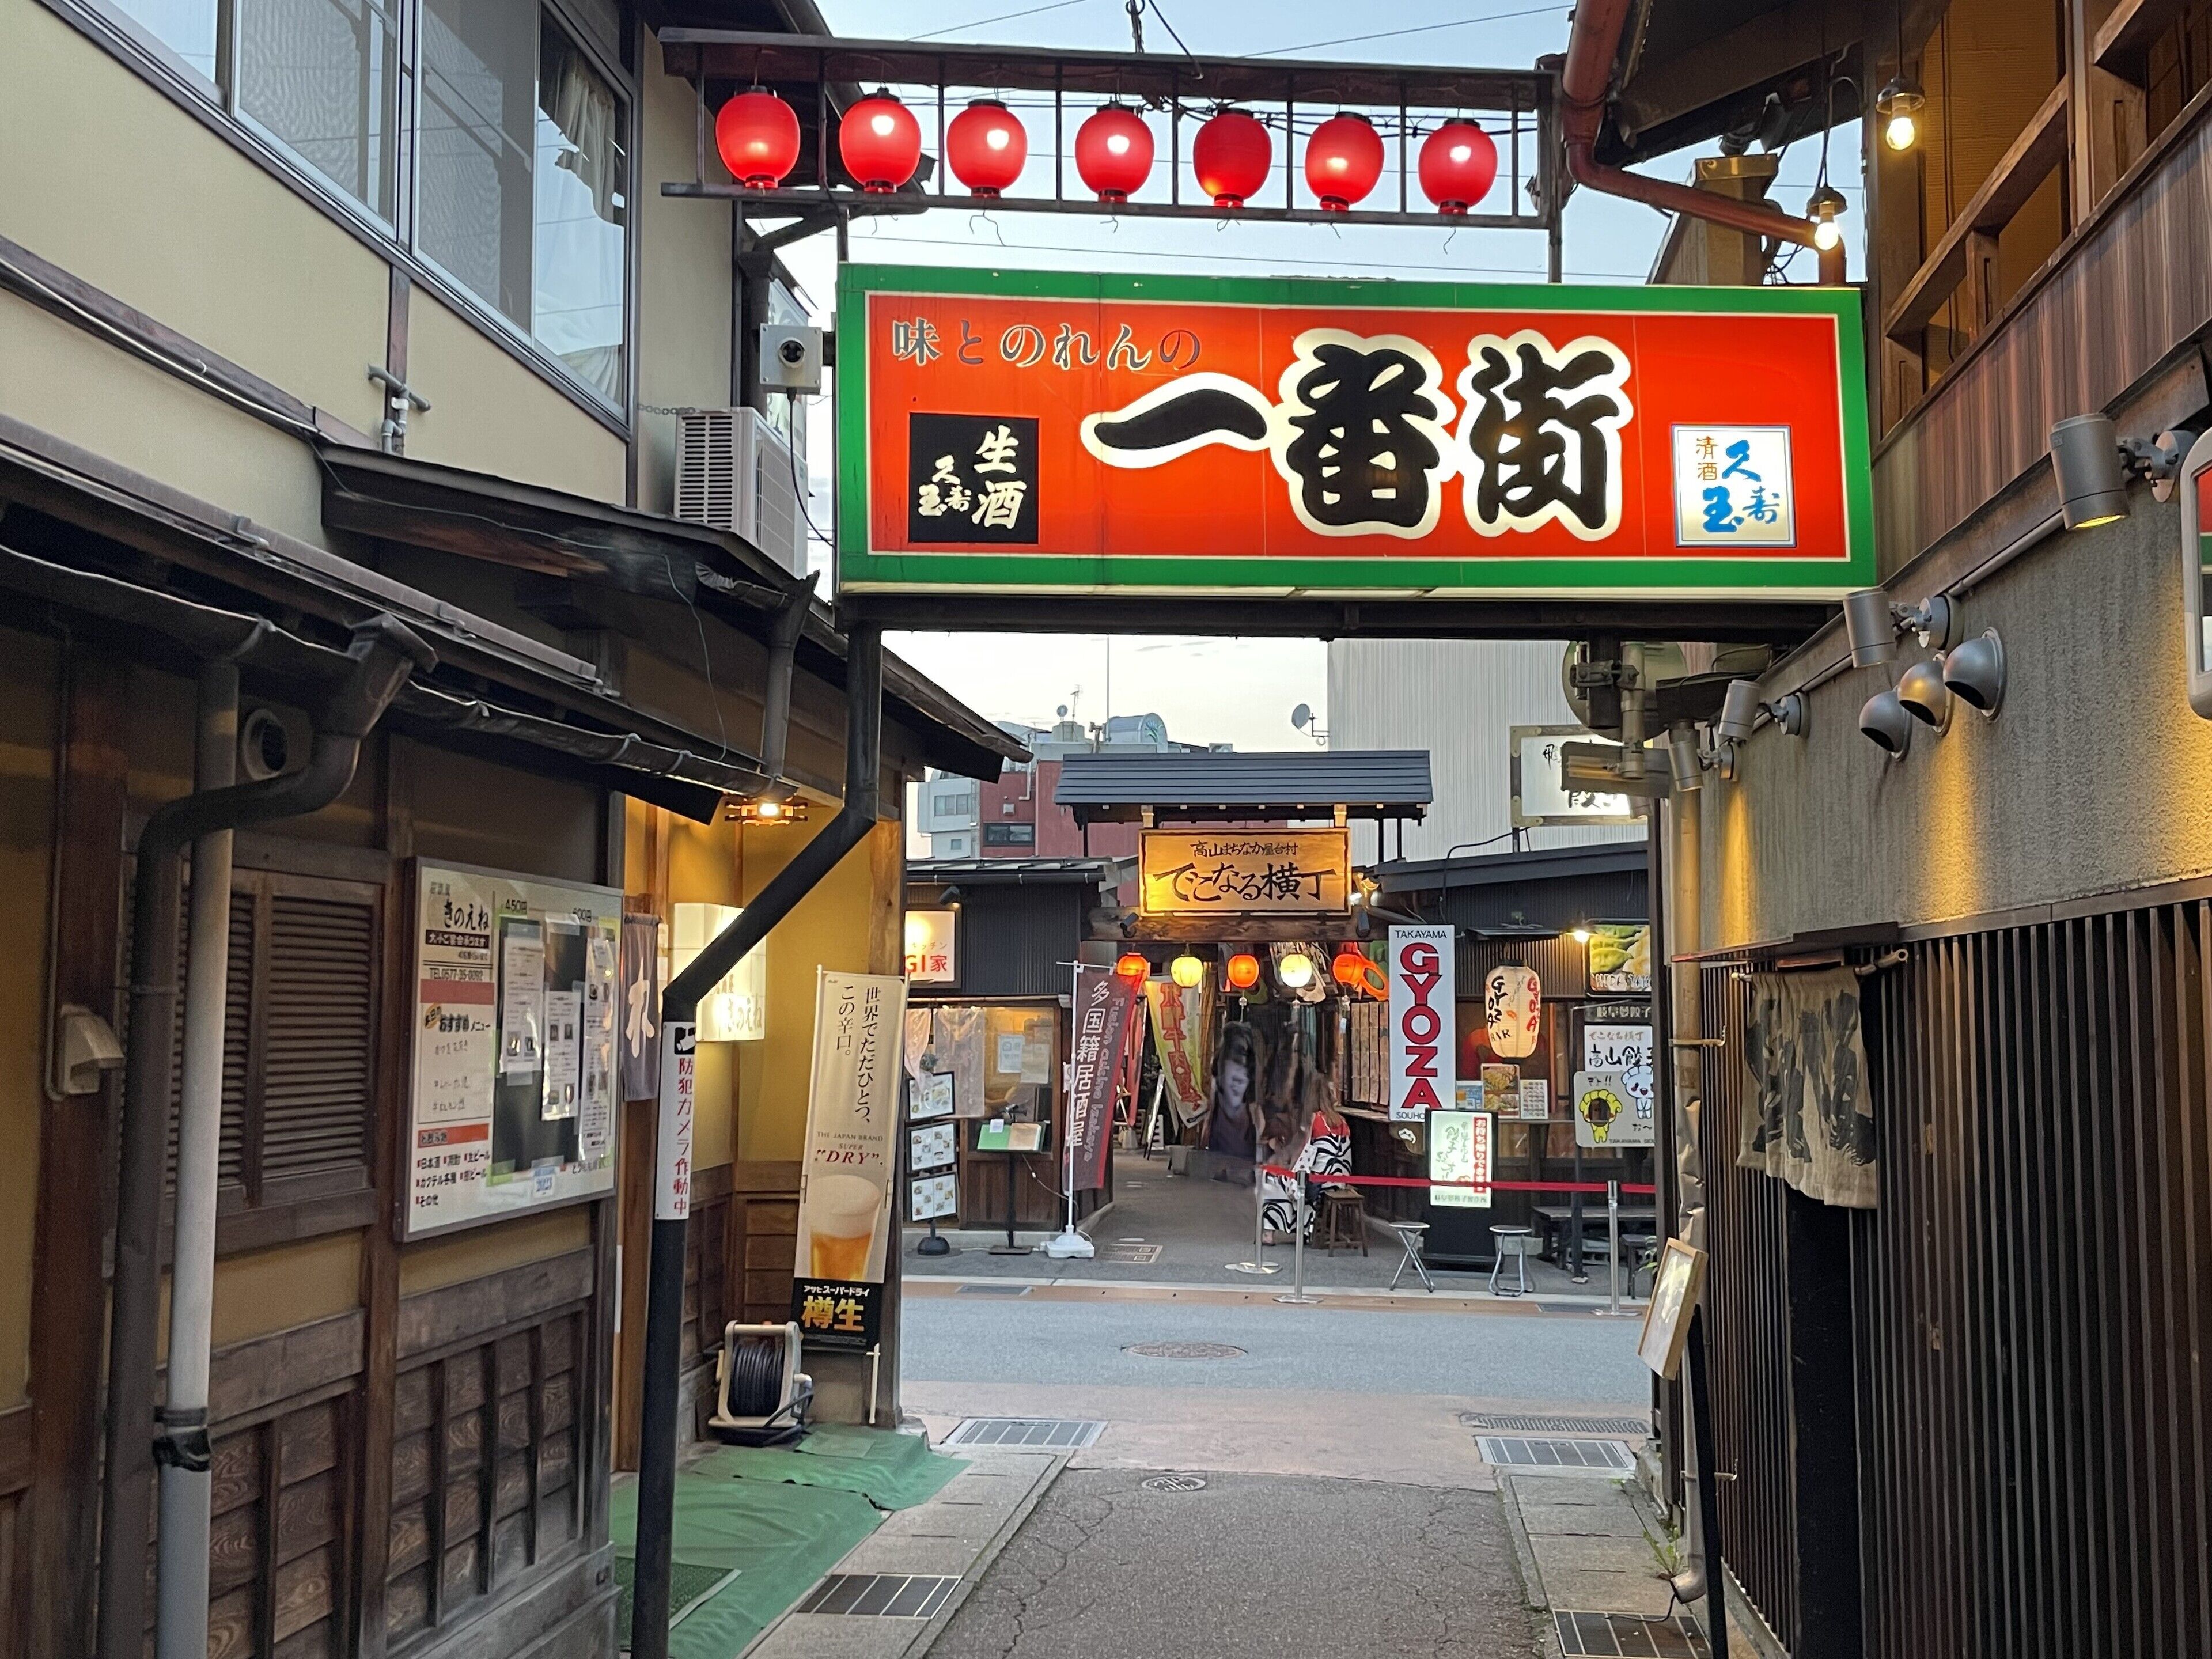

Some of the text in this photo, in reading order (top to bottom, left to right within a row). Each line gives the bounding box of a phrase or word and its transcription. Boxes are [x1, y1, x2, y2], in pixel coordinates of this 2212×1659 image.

[892, 317, 1202, 370] 味とのれんの
[1090, 339, 1622, 532] 一番街
[971, 424, 1028, 529] 生酒
[1695, 435, 1719, 481] 清酒
[1190, 839, 1299, 858] 高山まちなか屋台村
[1152, 861, 1338, 902] でこなる横丁
[443, 899, 491, 931] きのえね
[1395, 929, 1448, 939] TAKAYAMA
[836, 984, 855, 1056] この辛口。
[1399, 942, 1443, 1109] GYOZA
[673, 1056, 694, 1215] 防犯カメラ作動中
[838, 1143, 863, 1151] SUPER
[858, 1134, 884, 1142] BRAND
[804, 1284, 870, 1297] アサヒスーパードライ
[801, 1294, 865, 1332] 樽生
